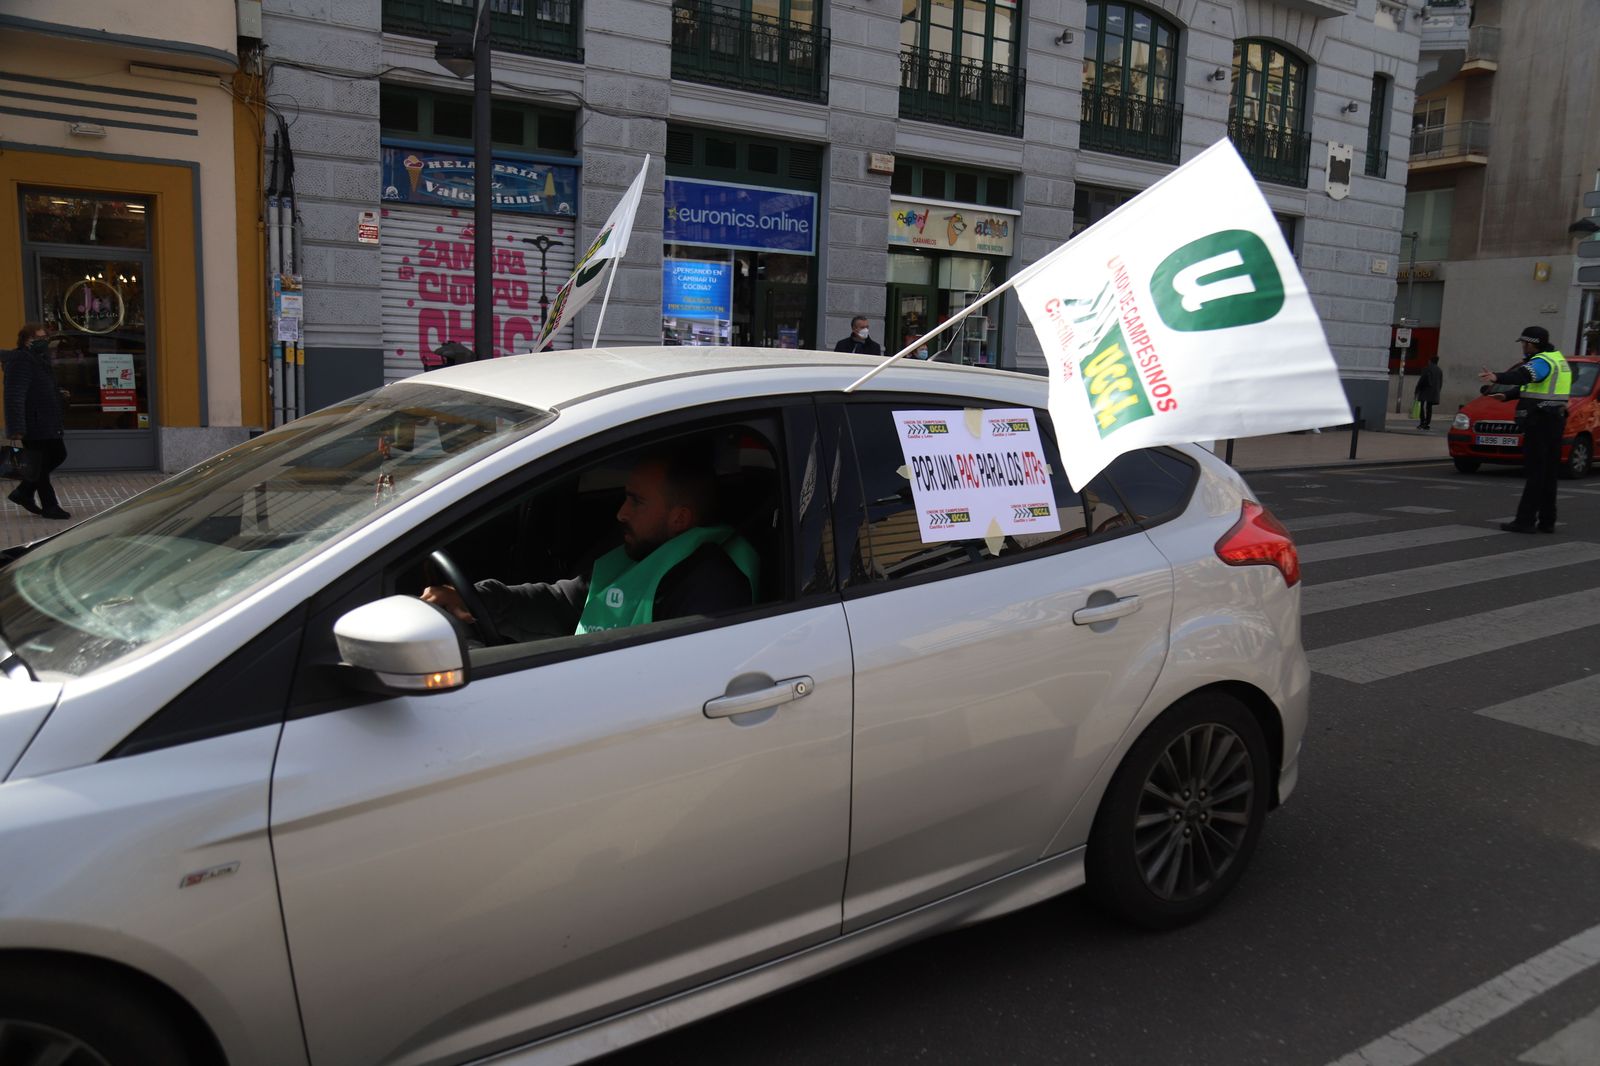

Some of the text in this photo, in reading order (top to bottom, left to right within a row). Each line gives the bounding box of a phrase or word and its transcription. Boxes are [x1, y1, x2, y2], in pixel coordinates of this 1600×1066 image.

[428, 160, 538, 180] HELAERIA
[425, 180, 540, 204] Valeiana
[679, 207, 809, 233] euronics.online
[418, 239, 527, 275] ZAMRA
[682, 283, 712, 291] COCINA?
[1119, 290, 1135, 308] DE
[1122, 305, 1178, 413] CAMPESINOS
[1013, 423, 1028, 431] UCCL
[912, 451, 1046, 491] POR UNA PAC PARA LOS ATPs
[952, 513, 968, 522] UCCL
[1033, 508, 1049, 516] UCCL
